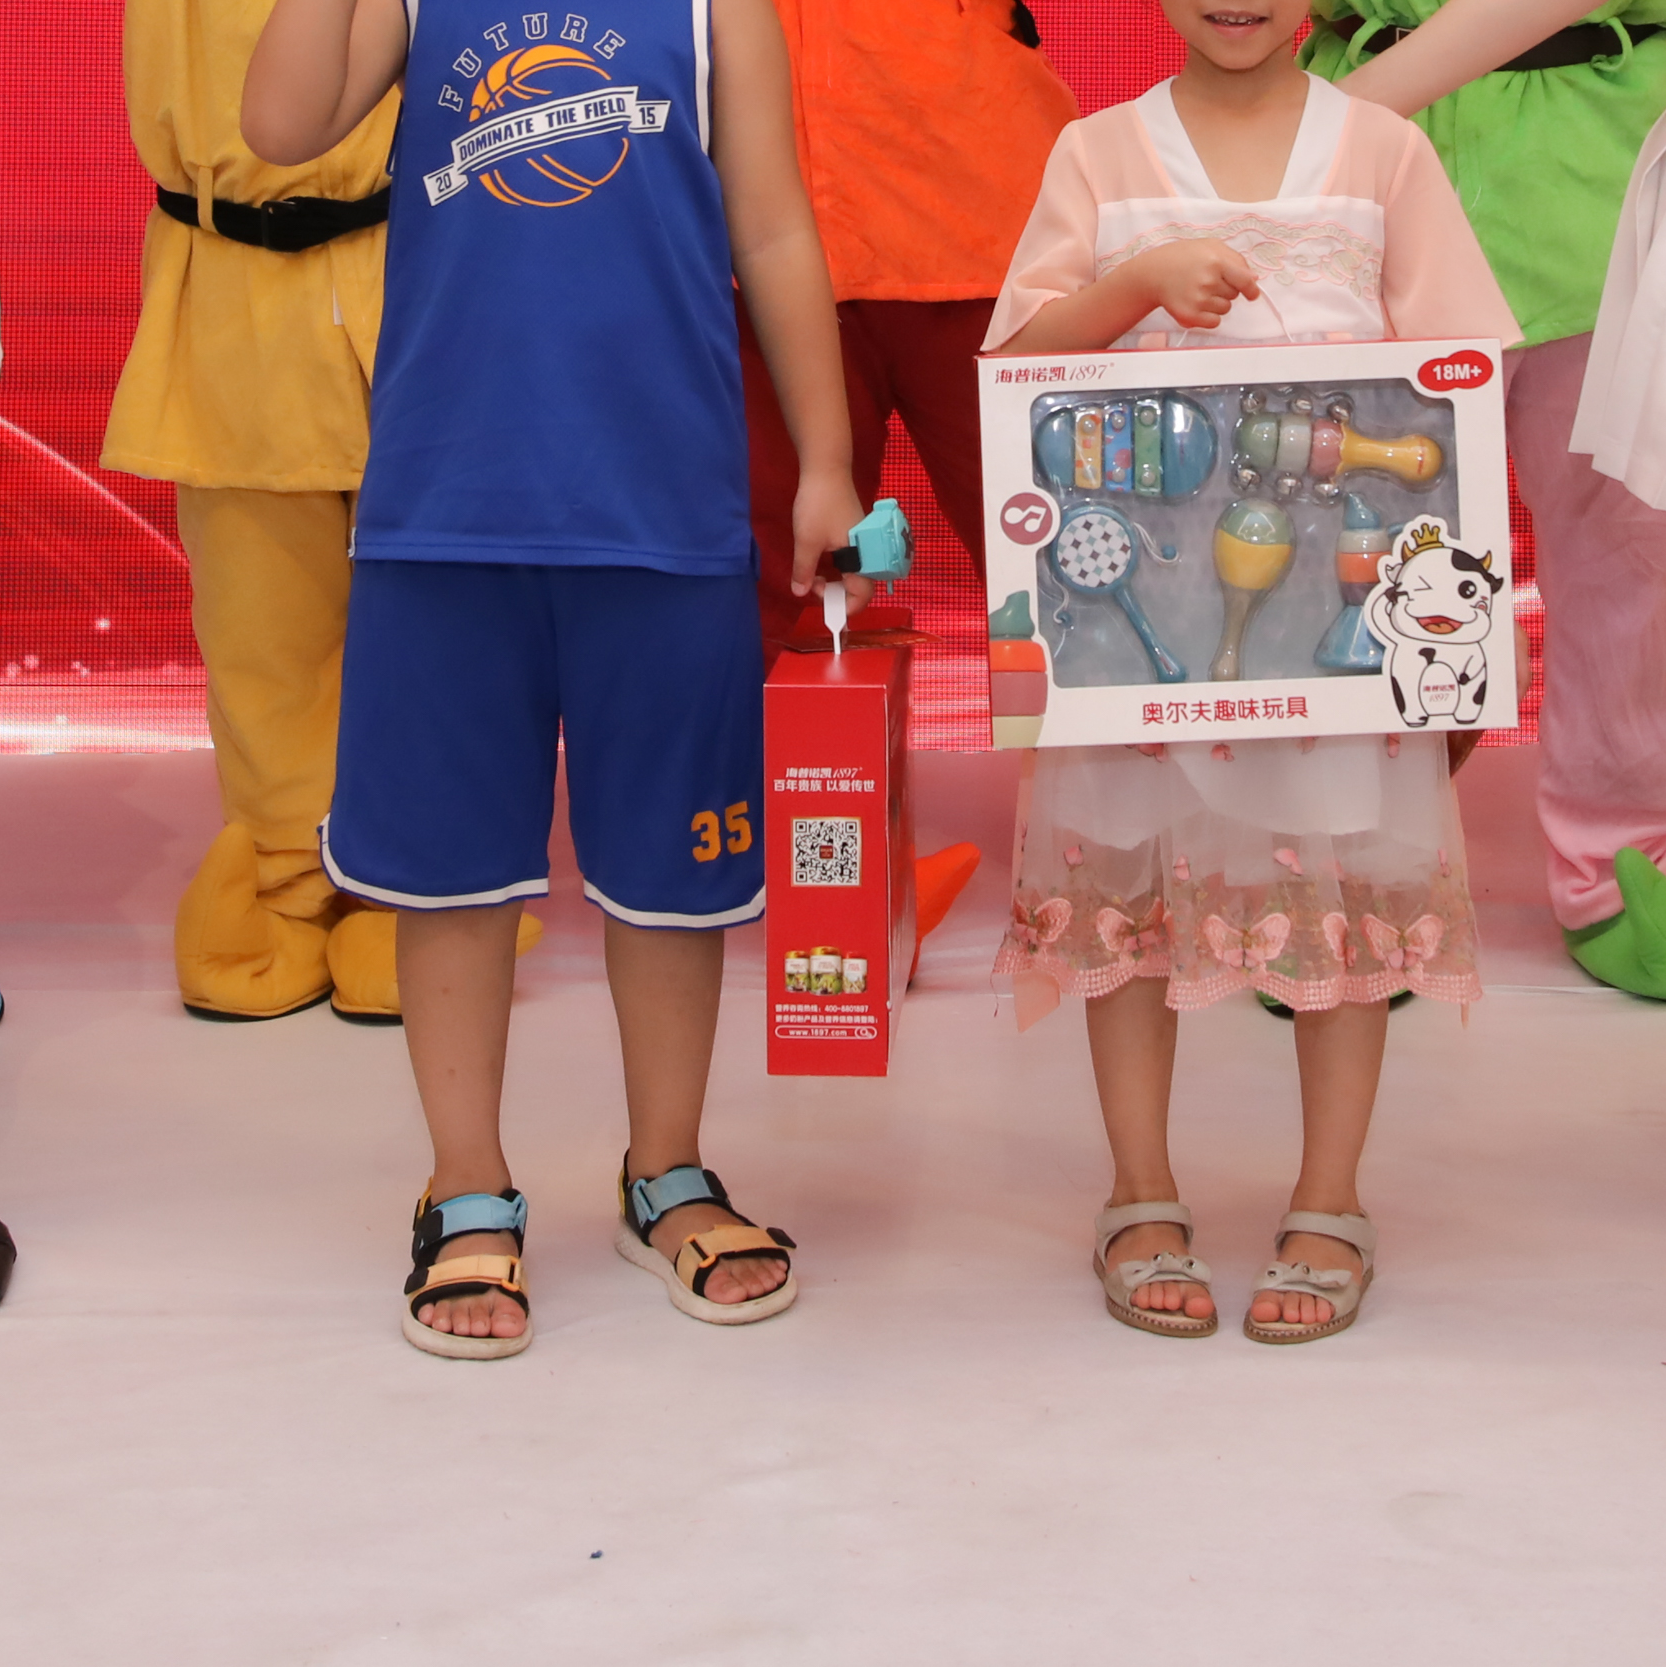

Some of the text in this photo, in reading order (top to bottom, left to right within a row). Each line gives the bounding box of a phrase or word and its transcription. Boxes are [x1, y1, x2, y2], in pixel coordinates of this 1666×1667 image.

[438, 12, 626, 112] FUTURE
[458, 118, 536, 161] DOMINATE
[545, 108, 577, 129] THE
[584, 97, 627, 120] FIELD
[639, 106, 657, 126] 15
[1432, 362, 1483, 381] 18M+
[1142, 696, 1309, 726] 奥尔夫趣味玩具
[689, 800, 753, 863] 35
